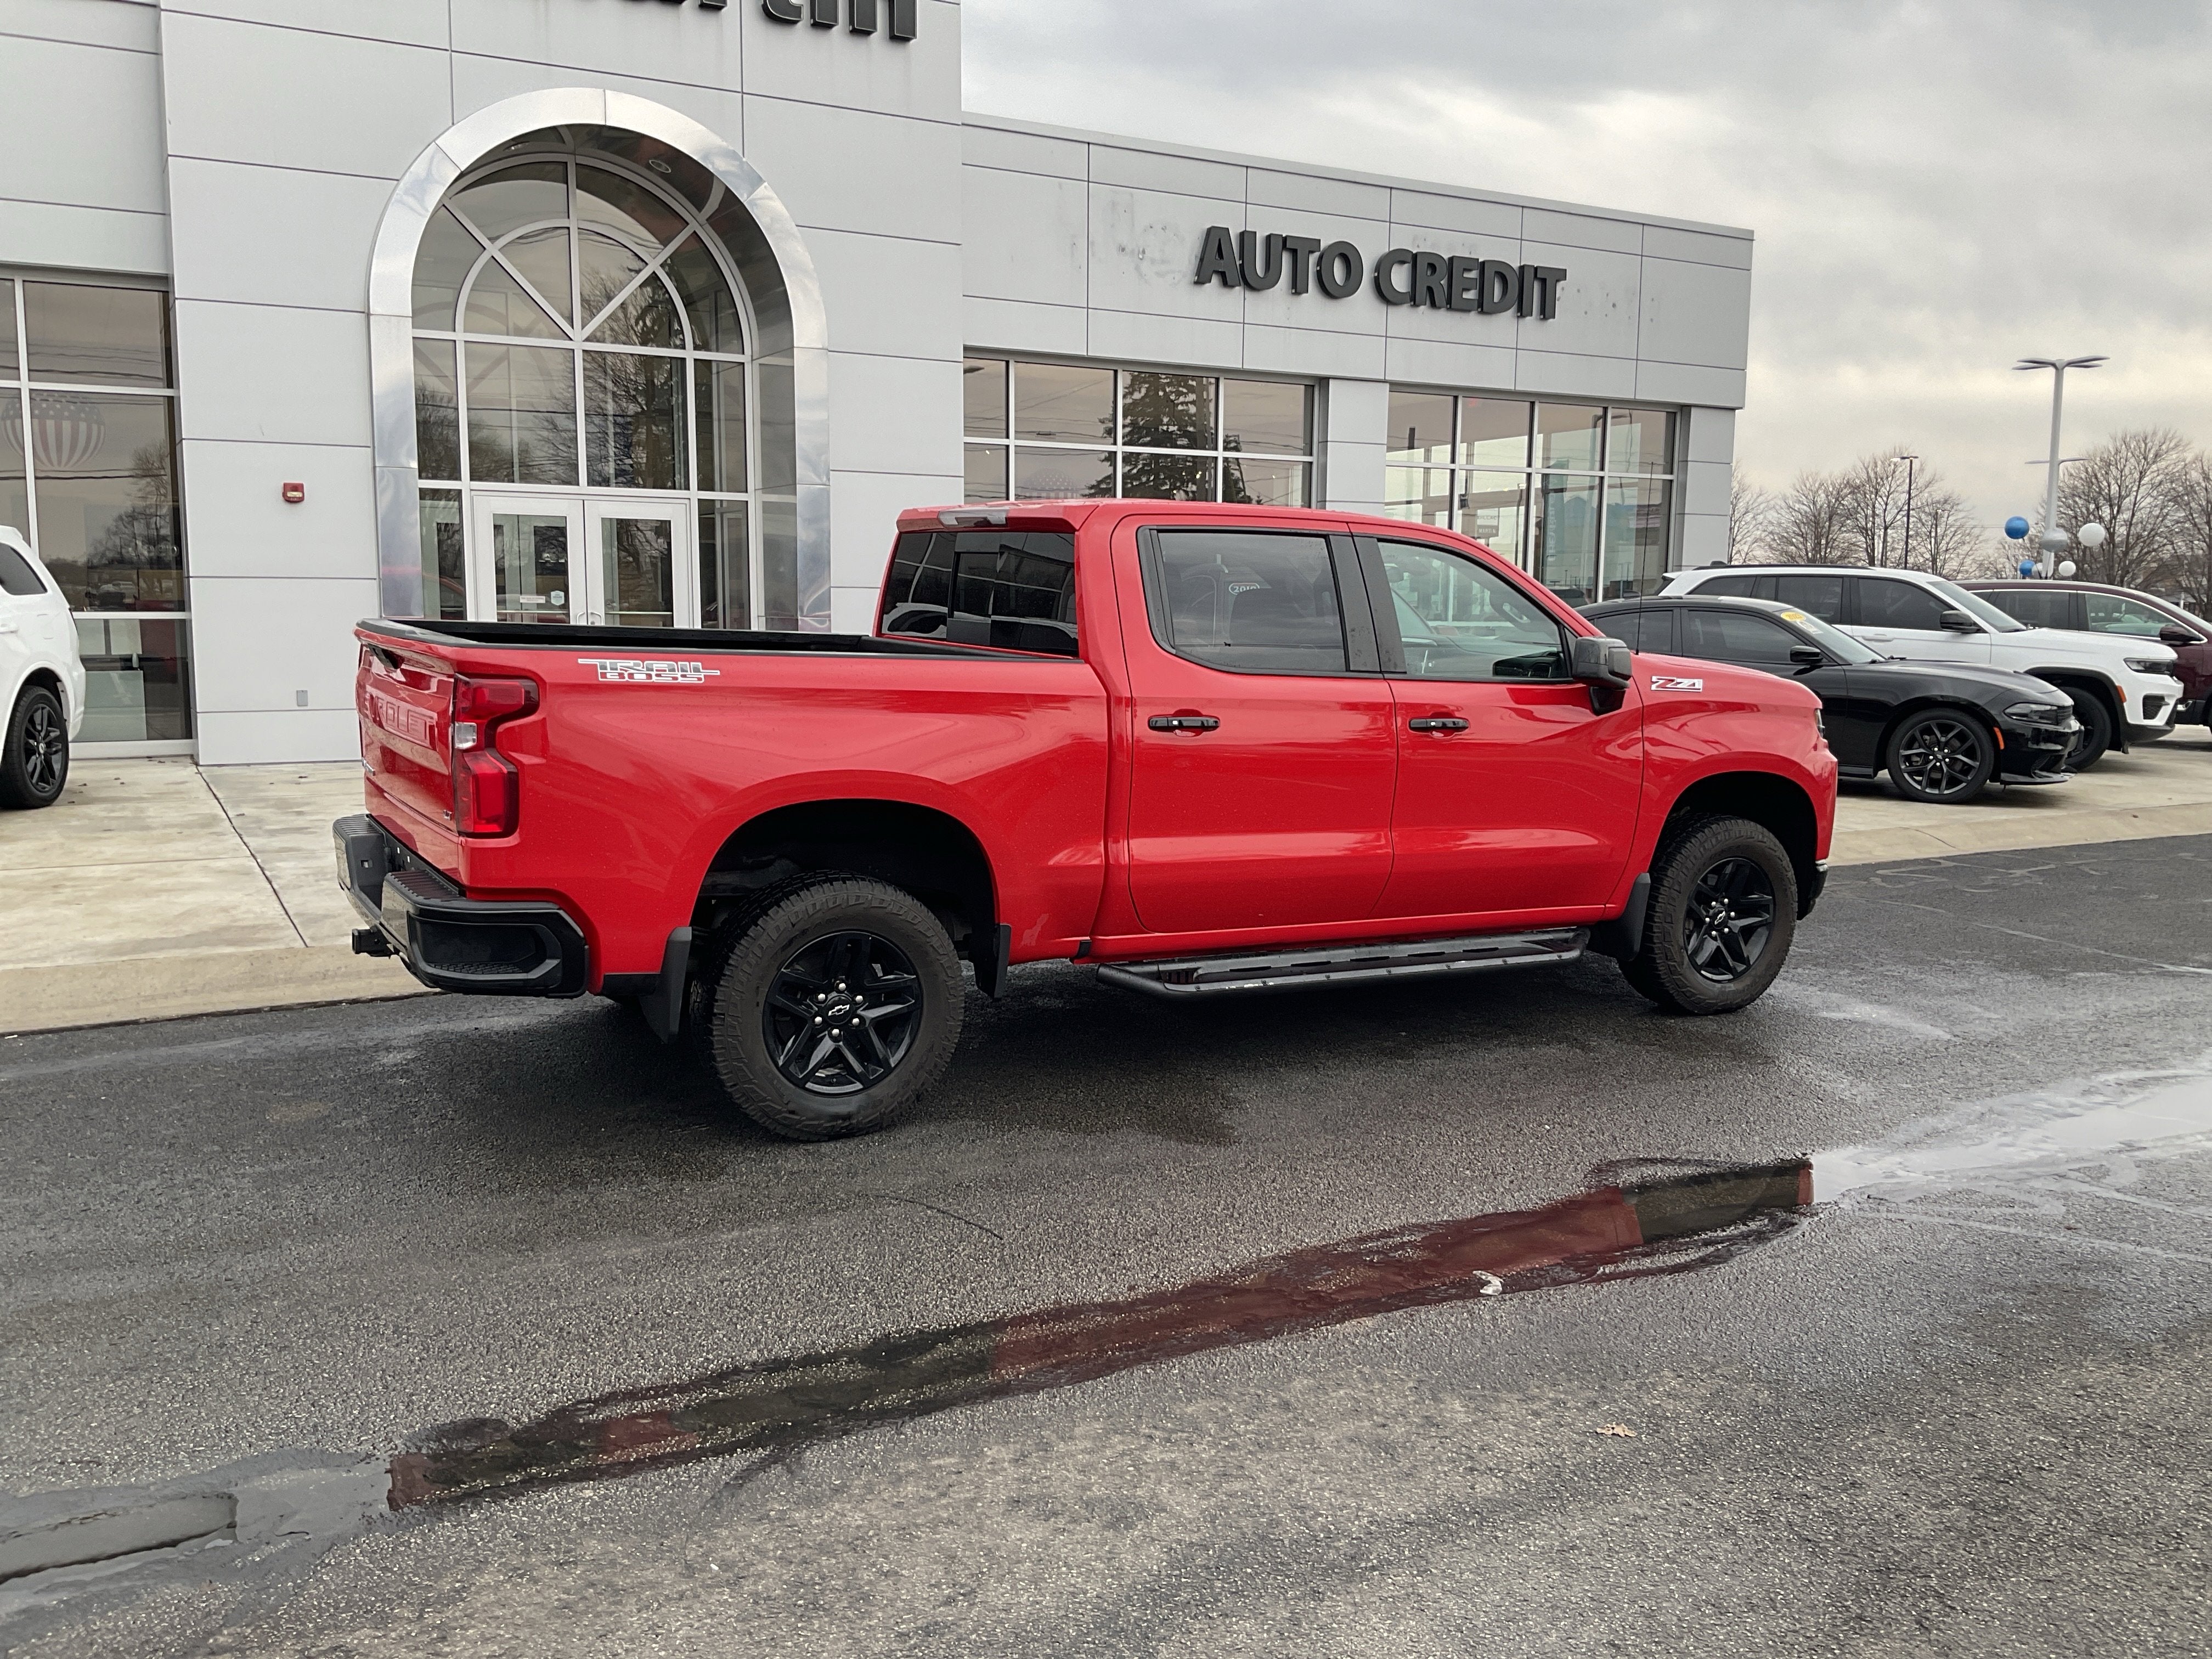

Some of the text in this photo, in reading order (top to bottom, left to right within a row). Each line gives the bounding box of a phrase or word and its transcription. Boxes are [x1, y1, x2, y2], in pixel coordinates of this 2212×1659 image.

[1194, 225, 1567, 320] AUTO CREDIT
[578, 658, 720, 675] TRAIL
[599, 670, 705, 684] BOSS
[1651, 675, 1703, 692] Z71
